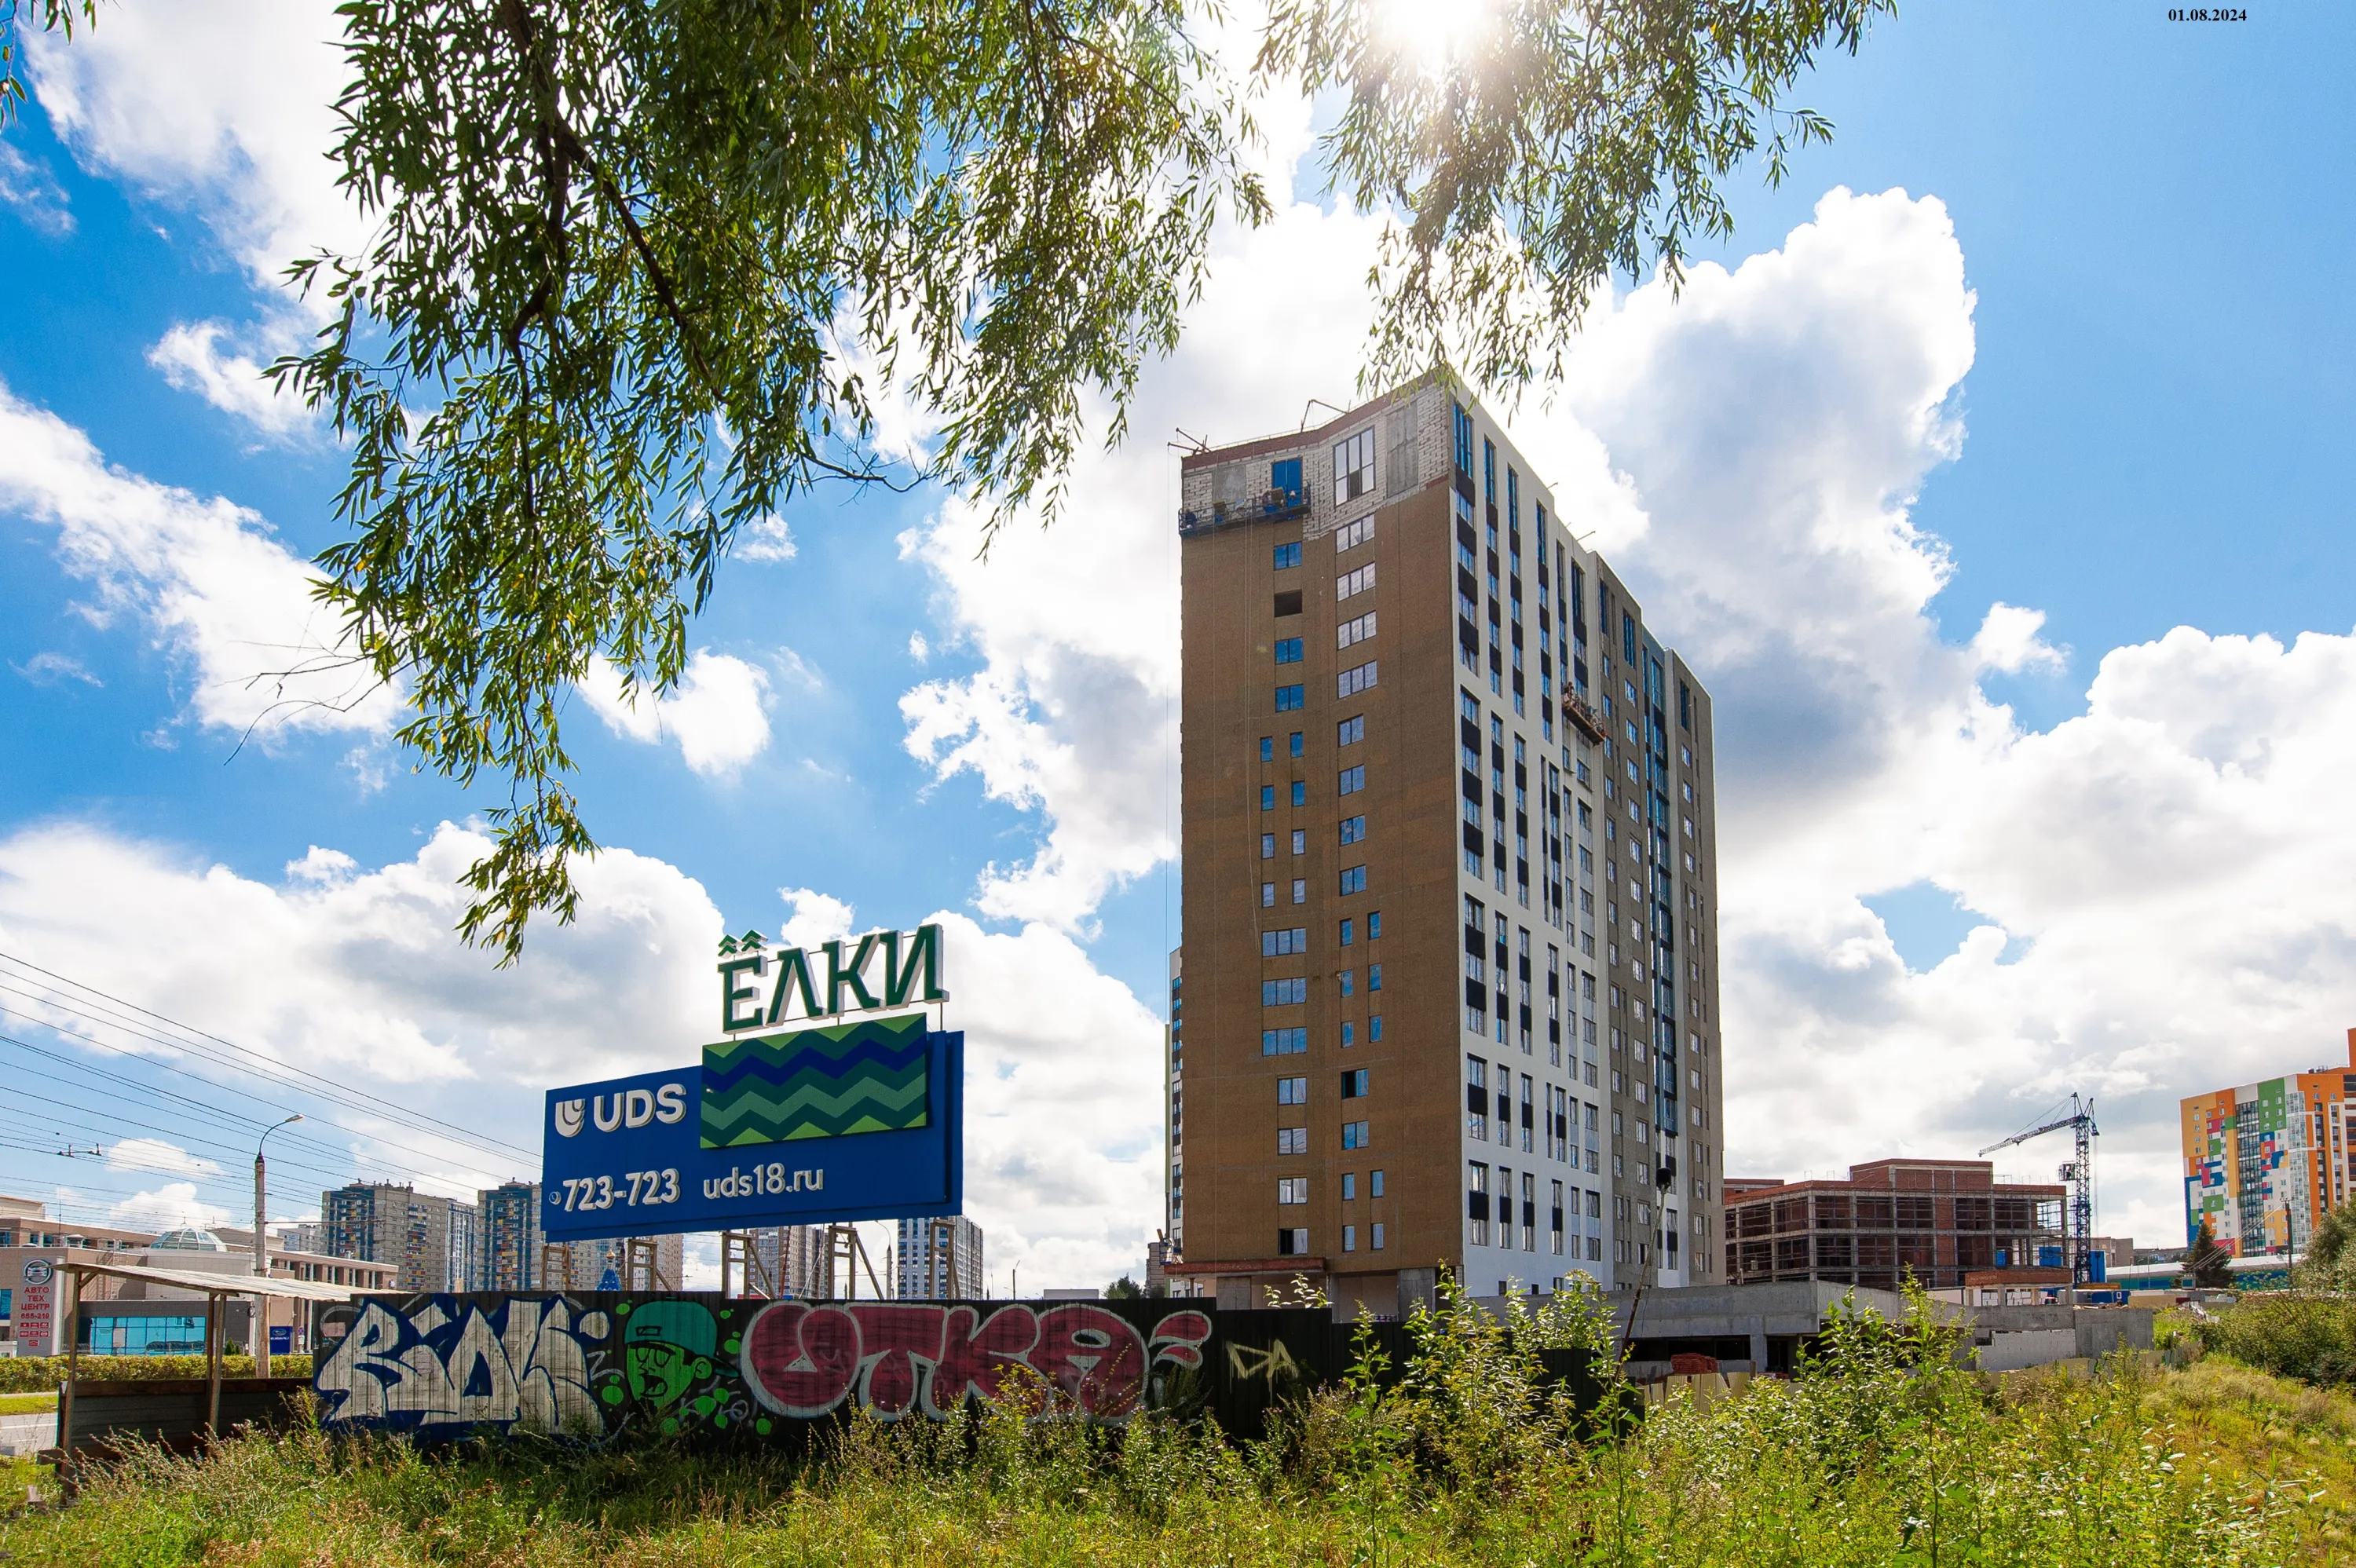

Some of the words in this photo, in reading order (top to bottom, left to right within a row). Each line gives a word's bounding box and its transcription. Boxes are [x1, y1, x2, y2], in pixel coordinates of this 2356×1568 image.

[718, 923, 949, 1034] ЁЛКИ
[594, 1083, 687, 1133] UDS
[562, 1168, 682, 1212] 723-723
[703, 1162, 824, 1199] uds18.ru
